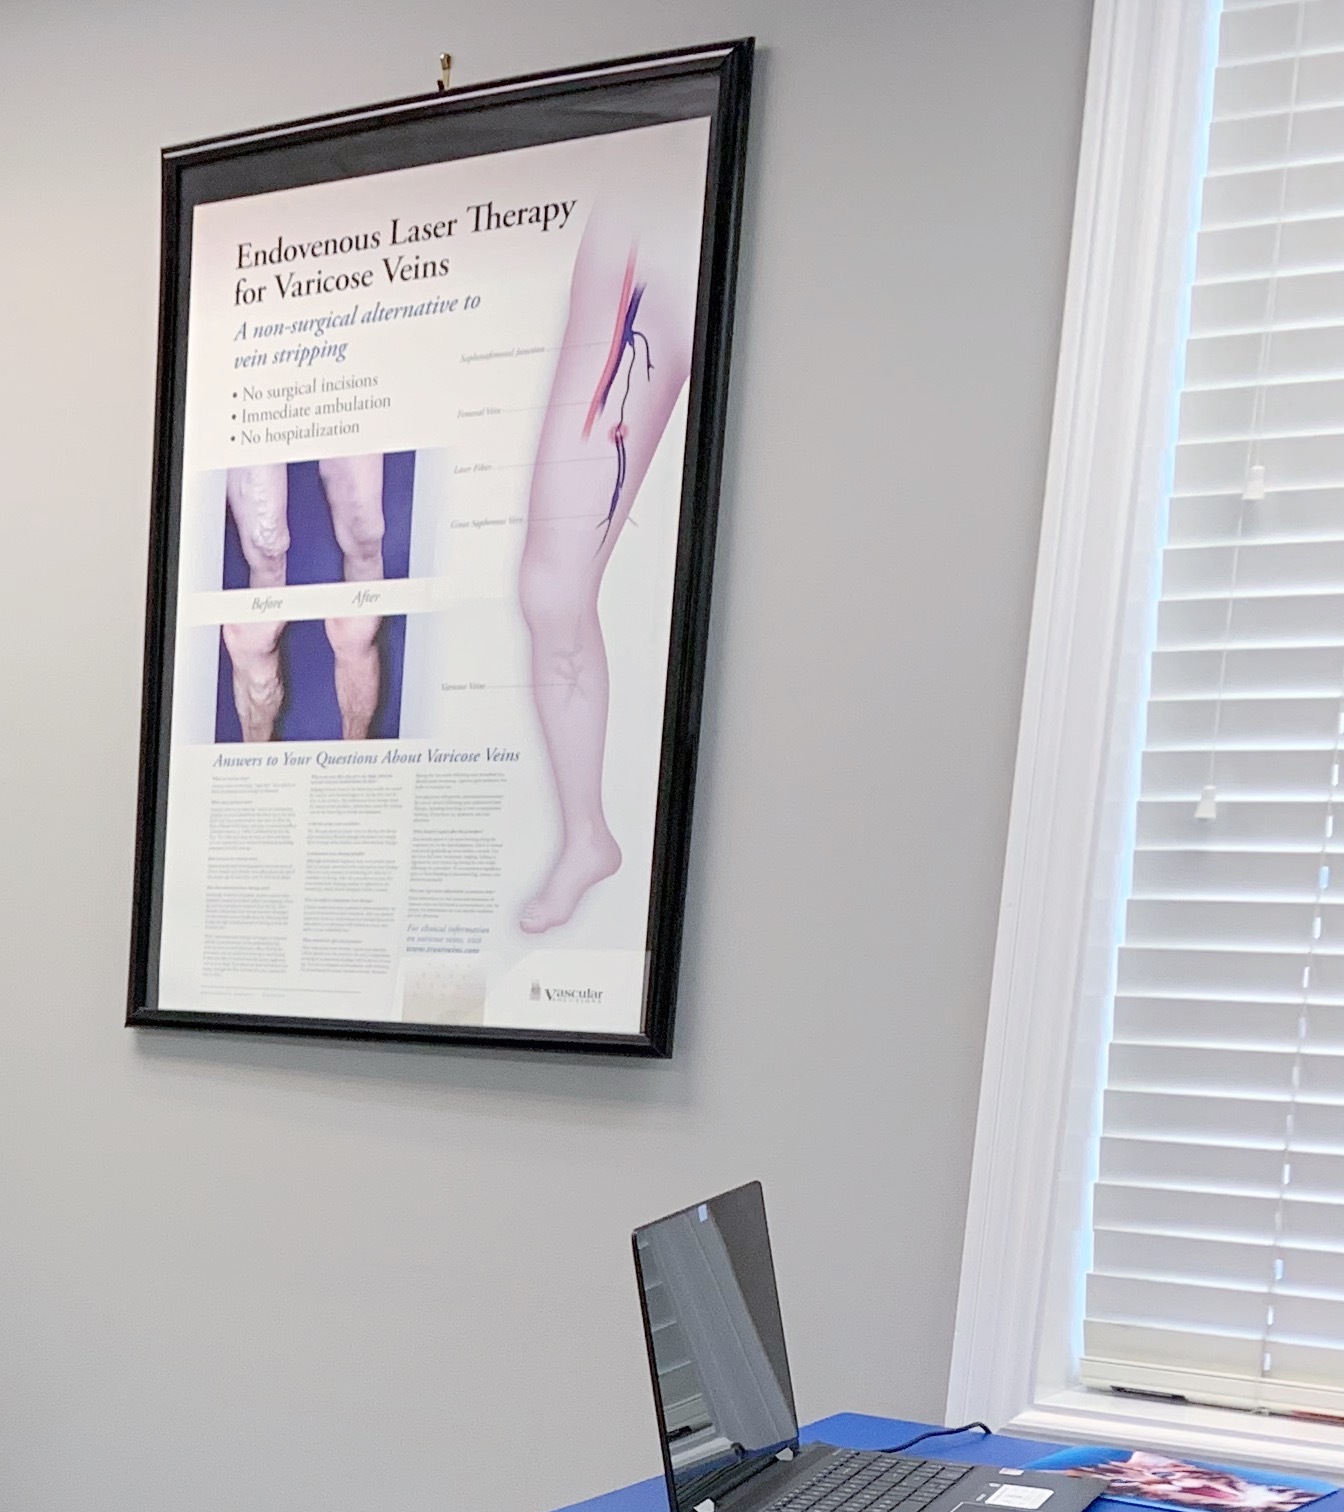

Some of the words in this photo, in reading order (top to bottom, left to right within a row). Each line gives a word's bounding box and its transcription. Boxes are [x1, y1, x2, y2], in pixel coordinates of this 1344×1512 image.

[236, 231, 381, 270] Endovenous
[389, 218, 458, 246] Laser
[466, 200, 577, 232] Therapy
[234, 277, 267, 306] for
[274, 269, 374, 299] Varicose
[382, 255, 450, 284] Veins
[233, 321, 248, 342] A
[253, 305, 358, 337] non-surgical
[361, 296, 459, 325] alternative
[464, 294, 481, 312] to
[234, 348, 267, 369] vein
[272, 342, 349, 368] stripping
[243, 386, 263, 402] No
[267, 378, 316, 401] surgical
[321, 374, 379, 393] incisions
[242, 403, 311, 423] Immediate
[315, 395, 391, 416] ambulation
[241, 430, 261, 445] No
[265, 420, 360, 445] hospitalization
[251, 596, 283, 614] Before
[351, 589, 382, 608] After
[213, 753, 263, 768] Answers
[266, 756, 279, 767] to
[283, 751, 312, 766] Your
[316, 750, 378, 768] Questions
[381, 748, 422, 765] About
[427, 747, 481, 763] Varicose
[485, 746, 521, 763] Veins
[545, 988, 603, 1001] Vascular
